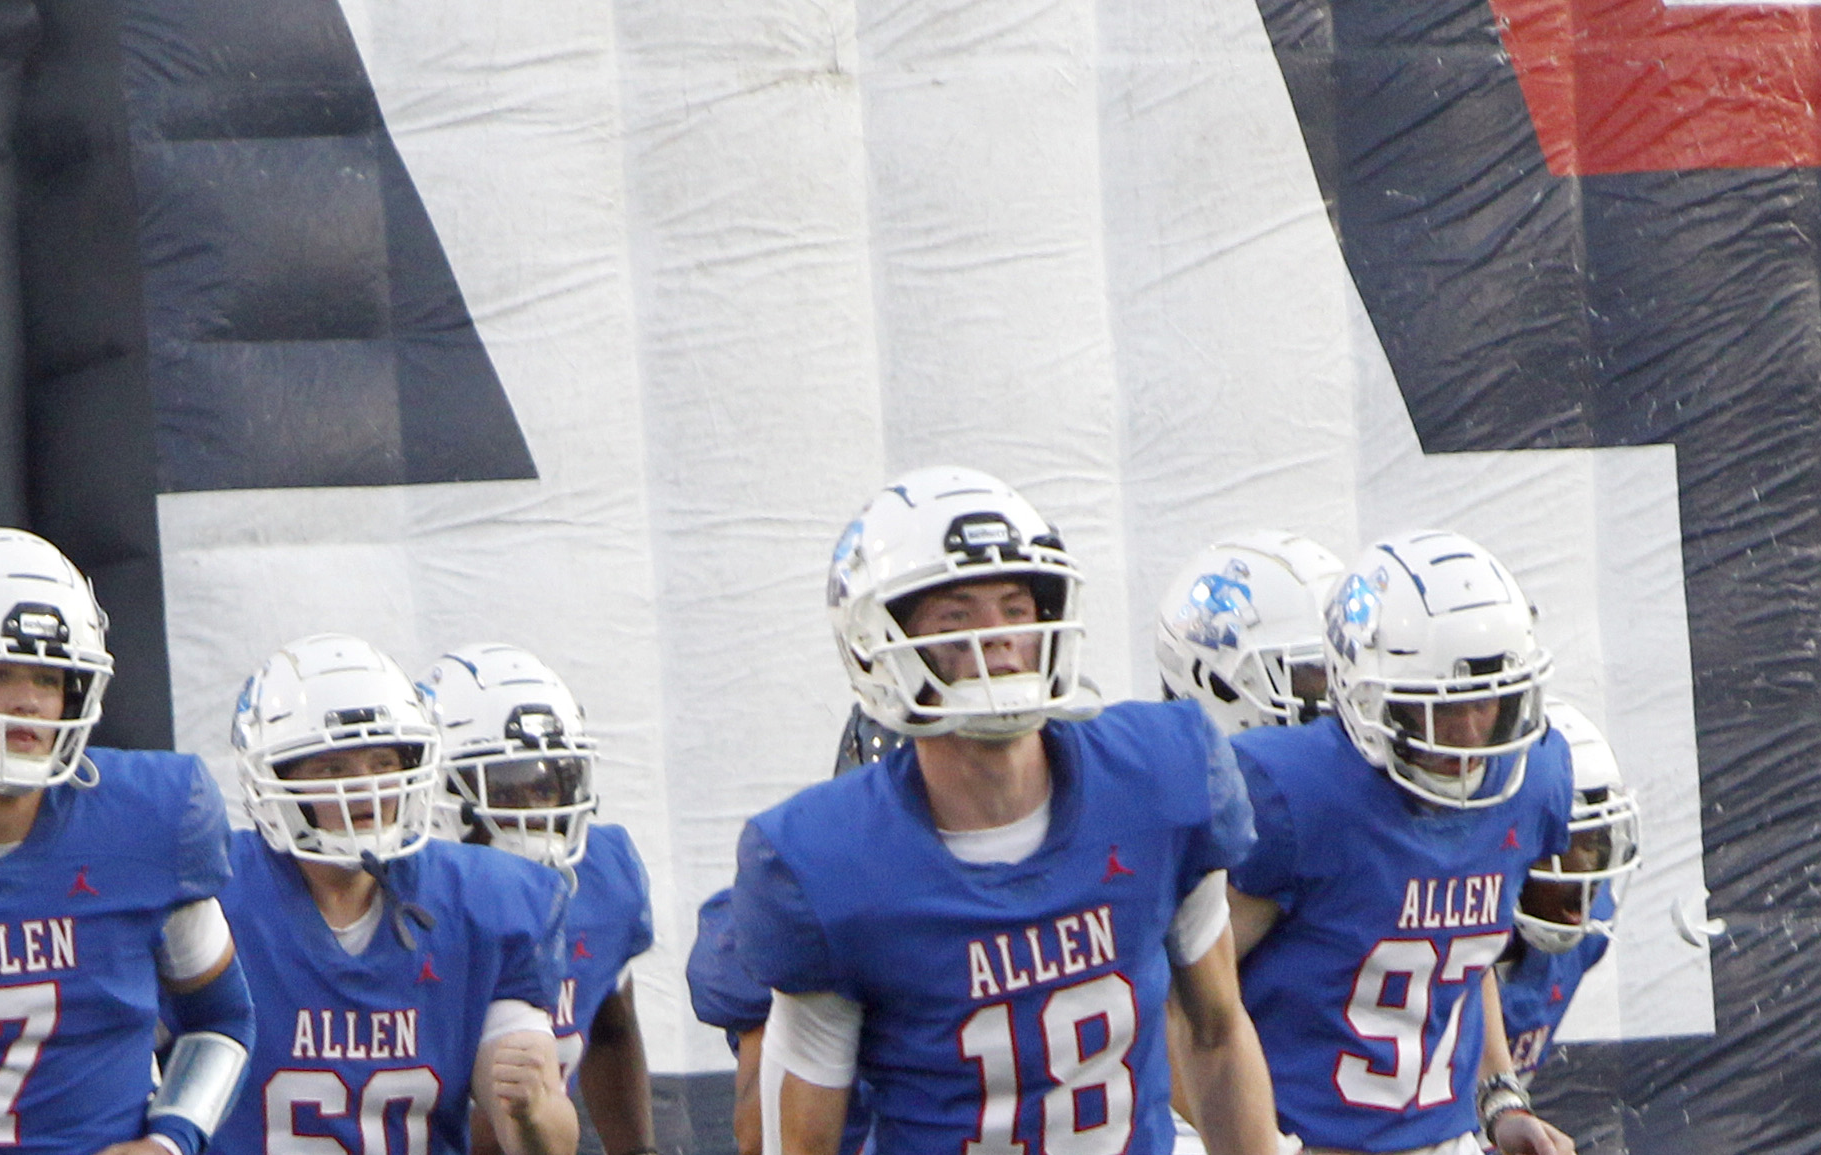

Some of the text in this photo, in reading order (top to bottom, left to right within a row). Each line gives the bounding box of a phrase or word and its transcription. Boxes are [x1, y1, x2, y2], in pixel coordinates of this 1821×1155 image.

[1396, 872, 1505, 930] ALLEN
[967, 904, 1117, 1000] ALLEN
[291, 1008, 419, 1060] ALLEN
[1332, 930, 1512, 1114] 97
